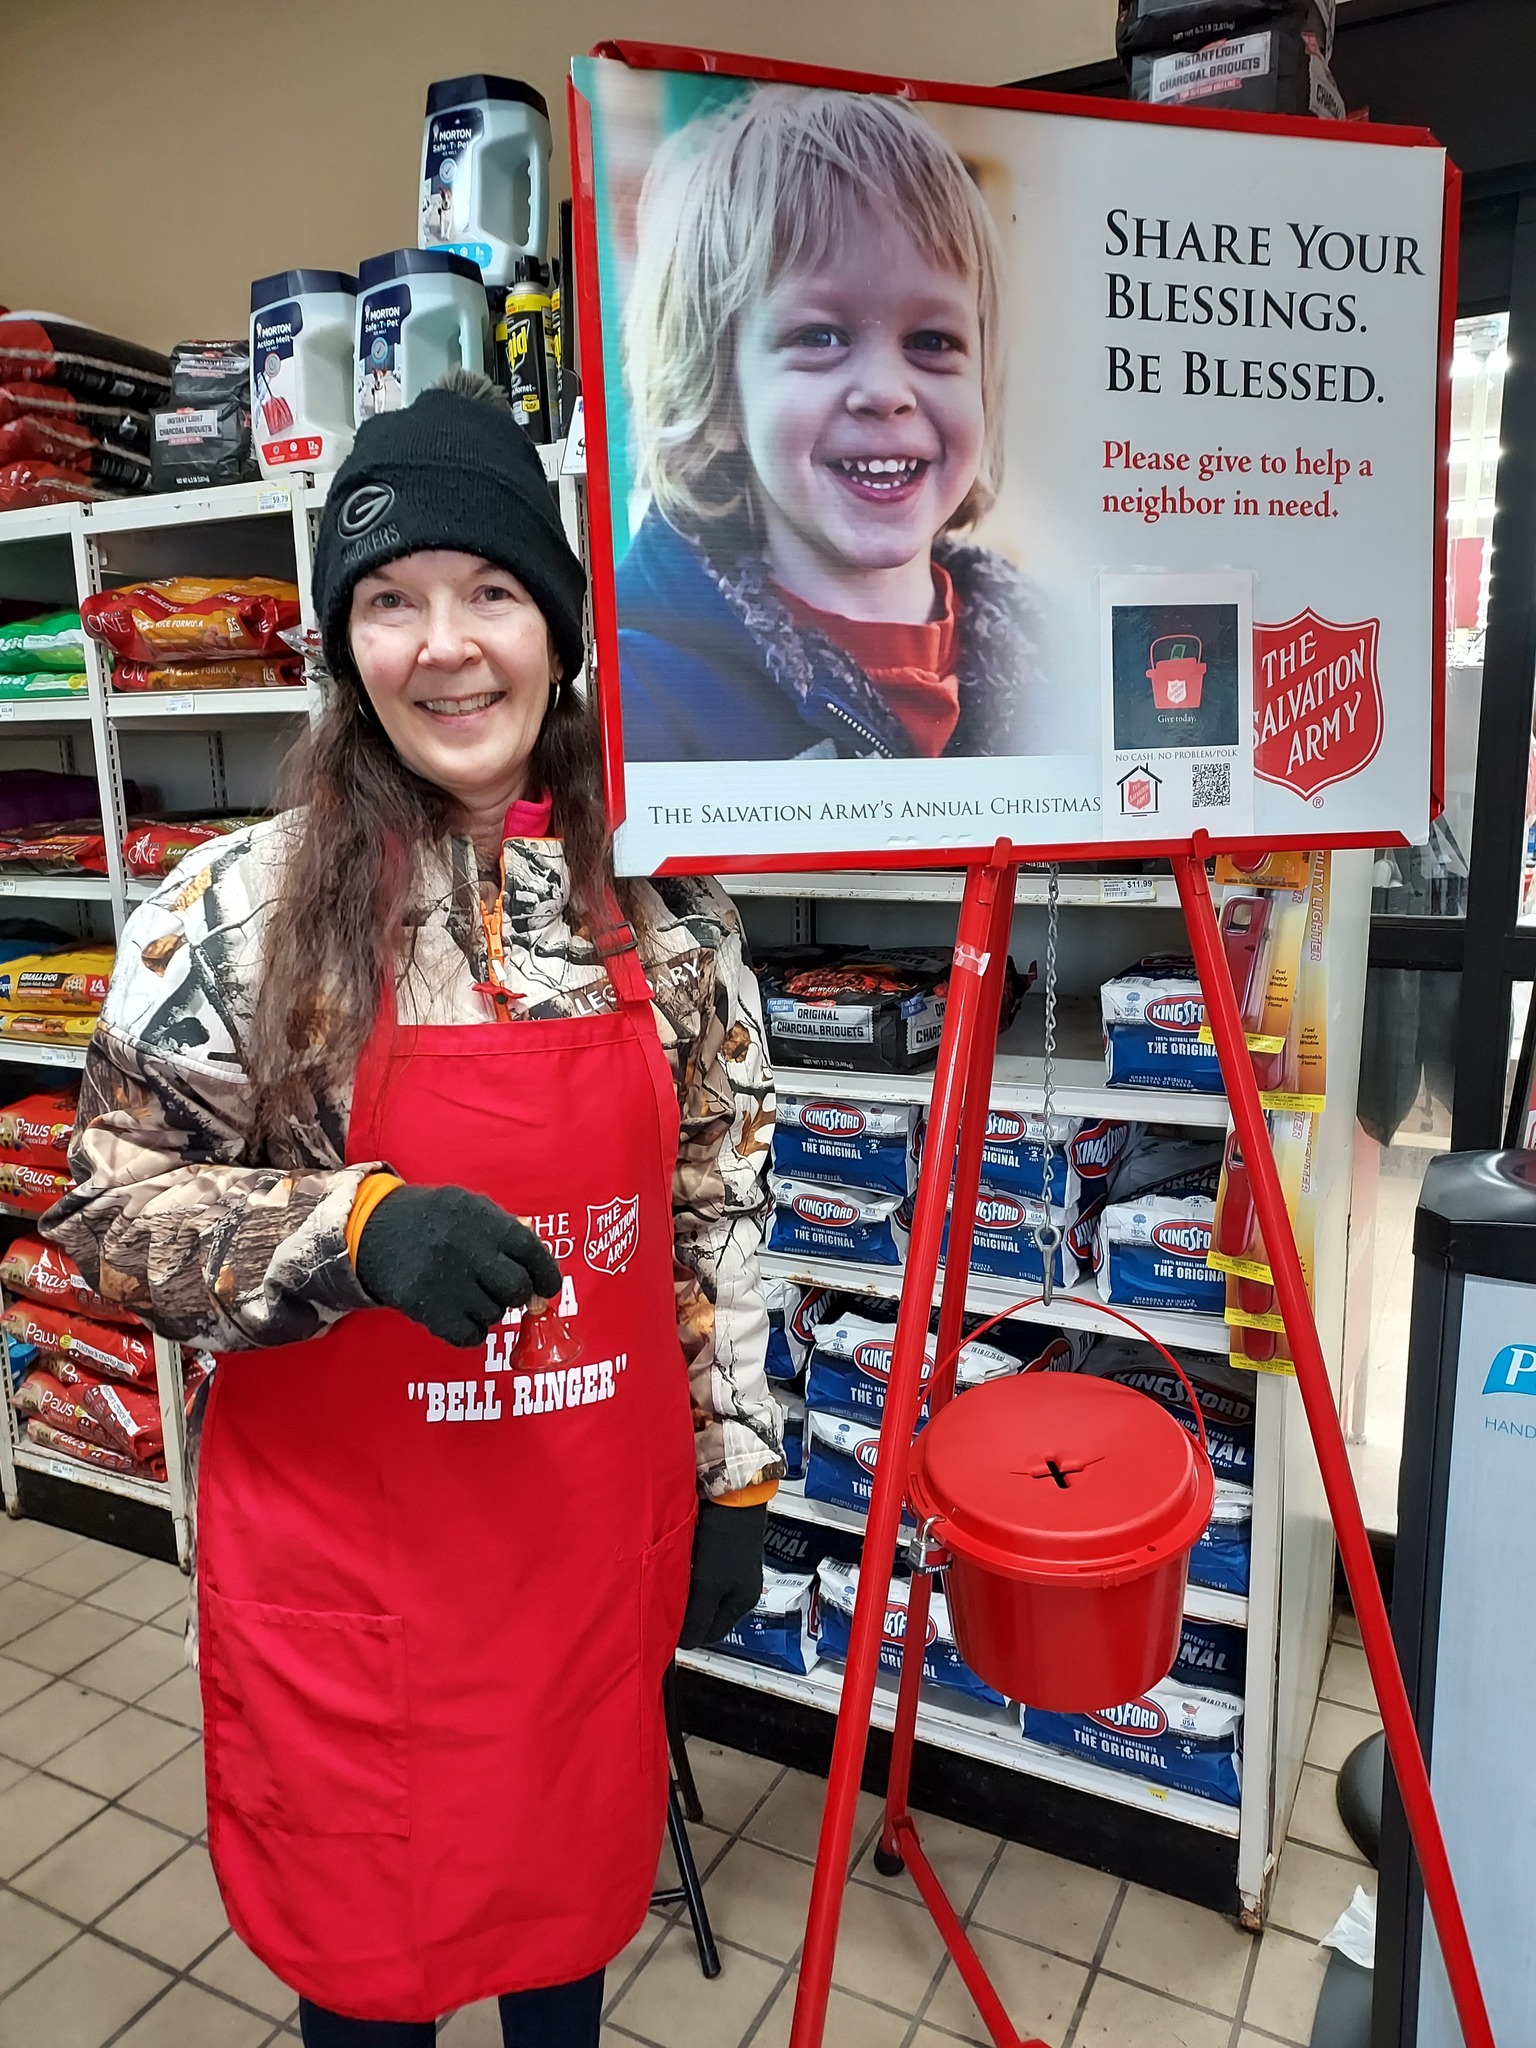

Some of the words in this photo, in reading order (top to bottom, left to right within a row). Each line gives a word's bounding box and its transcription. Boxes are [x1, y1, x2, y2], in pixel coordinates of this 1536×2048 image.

[1174, 51, 1213, 71] INSTANT
[1214, 43, 1245, 59] LIGHT
[1159, 68, 1208, 93] CHARCOAL
[1209, 57, 1260, 77] BRIQUETS
[439, 128, 472, 142] MORTON
[1105, 208, 1272, 266] SHARE
[1287, 222, 1426, 275] YOUR
[1104, 272, 1368, 333] BLESSINGS.
[370, 306, 400, 321] MORTON
[262, 323, 292, 338] MORTON
[257, 339, 275, 350] Action
[276, 335, 291, 345] Melt
[508, 326, 528, 360] aid
[1104, 346, 1162, 395] BE
[1182, 350, 1385, 404] BLESSED.
[167, 416, 187, 425] INSTANT
[187, 414, 203, 423] LIGHT
[159, 428, 185, 437] CHARCOAL
[185, 424, 213, 434] BRIQUETS
[1102, 440, 1190, 472] Please
[1198, 446, 1252, 481] give
[1259, 450, 1287, 475] to
[1294, 447, 1351, 484] help
[1358, 459, 1373, 478] a
[272, 495, 289, 504] $9.79
[1102, 485, 1226, 523] neighbor
[1233, 490, 1260, 516] in
[1267, 490, 1339, 518] need.
[86, 614, 130, 634] ONE
[172, 619, 204, 628] FORMULA
[1262, 630, 1317, 688] THE
[1157, 714, 1174, 723] Give
[1284, 690, 1362, 776] ARMY
[1158, 752, 1172, 760] NO
[649, 805, 693, 825] THE
[701, 804, 812, 823] SALVATION
[900, 800, 984, 819] ANNUAL
[990, 796, 1102, 815] CHRISTMAS
[1127, 880, 1153, 889] $11.99
[1310, 898, 1323, 962] LIGHTER
[20, 973, 43, 981] SMALL
[43, 974, 58, 982] DOG
[90, 980, 106, 993] 14
[574, 958, 701, 1016] LEGARY
[797, 1008, 840, 1021] ORIGINAL
[1153, 1000, 1204, 1026] KINGSFO
[776, 1021, 819, 1035] CHARCOAL
[820, 1025, 864, 1038] BRIQUETS
[916, 1026, 942, 1044] CHARC
[1147, 1042, 1168, 1054] THE
[1170, 1043, 1218, 1057] ORIGINA
[16, 1118, 51, 1138] Paws
[805, 1108, 860, 1131] KINGSFORD
[985, 1112, 1020, 1136] SFORD
[801, 1141, 818, 1153] THE
[819, 1144, 863, 1160] ORIGINAL
[982, 1150, 1020, 1168] RIGINAL
[16, 1166, 55, 1187] Paws
[596, 1204, 622, 1234] THE
[798, 1198, 854, 1220] KINGSFORD
[976, 1200, 1020, 1223] GSFORD
[588, 1202, 637, 1260] SALVATION
[794, 1228, 812, 1240] THE
[812, 1231, 855, 1248] ORIGINAL
[1159, 1226, 1212, 1252] KINGSFO
[605, 1225, 635, 1269] ARMY
[973, 1236, 1020, 1253] ORIGINAL
[28, 1263, 70, 1289] Paws
[1154, 1264, 1174, 1278] THE
[1176, 1267, 1224, 1282] ORIGINA
[41, 1390, 75, 1417] Paws
[851, 1387, 873, 1404] THE
[1113, 1373, 1250, 1420] KINGSORD
[1201, 1531, 1210, 1541] 4
[925, 1564, 950, 1574] Master
[950, 1654, 957, 1662] 4
[1182, 1718, 1195, 1727] USA
[1074, 1729, 1098, 1749] THE
[1101, 1740, 1168, 1769] ORIGINAL
[1098, 1732, 1122, 1744] NATURAL
[1122, 1737, 1157, 1753] INGREDIENTS
[1183, 1746, 1191, 1755] 4
